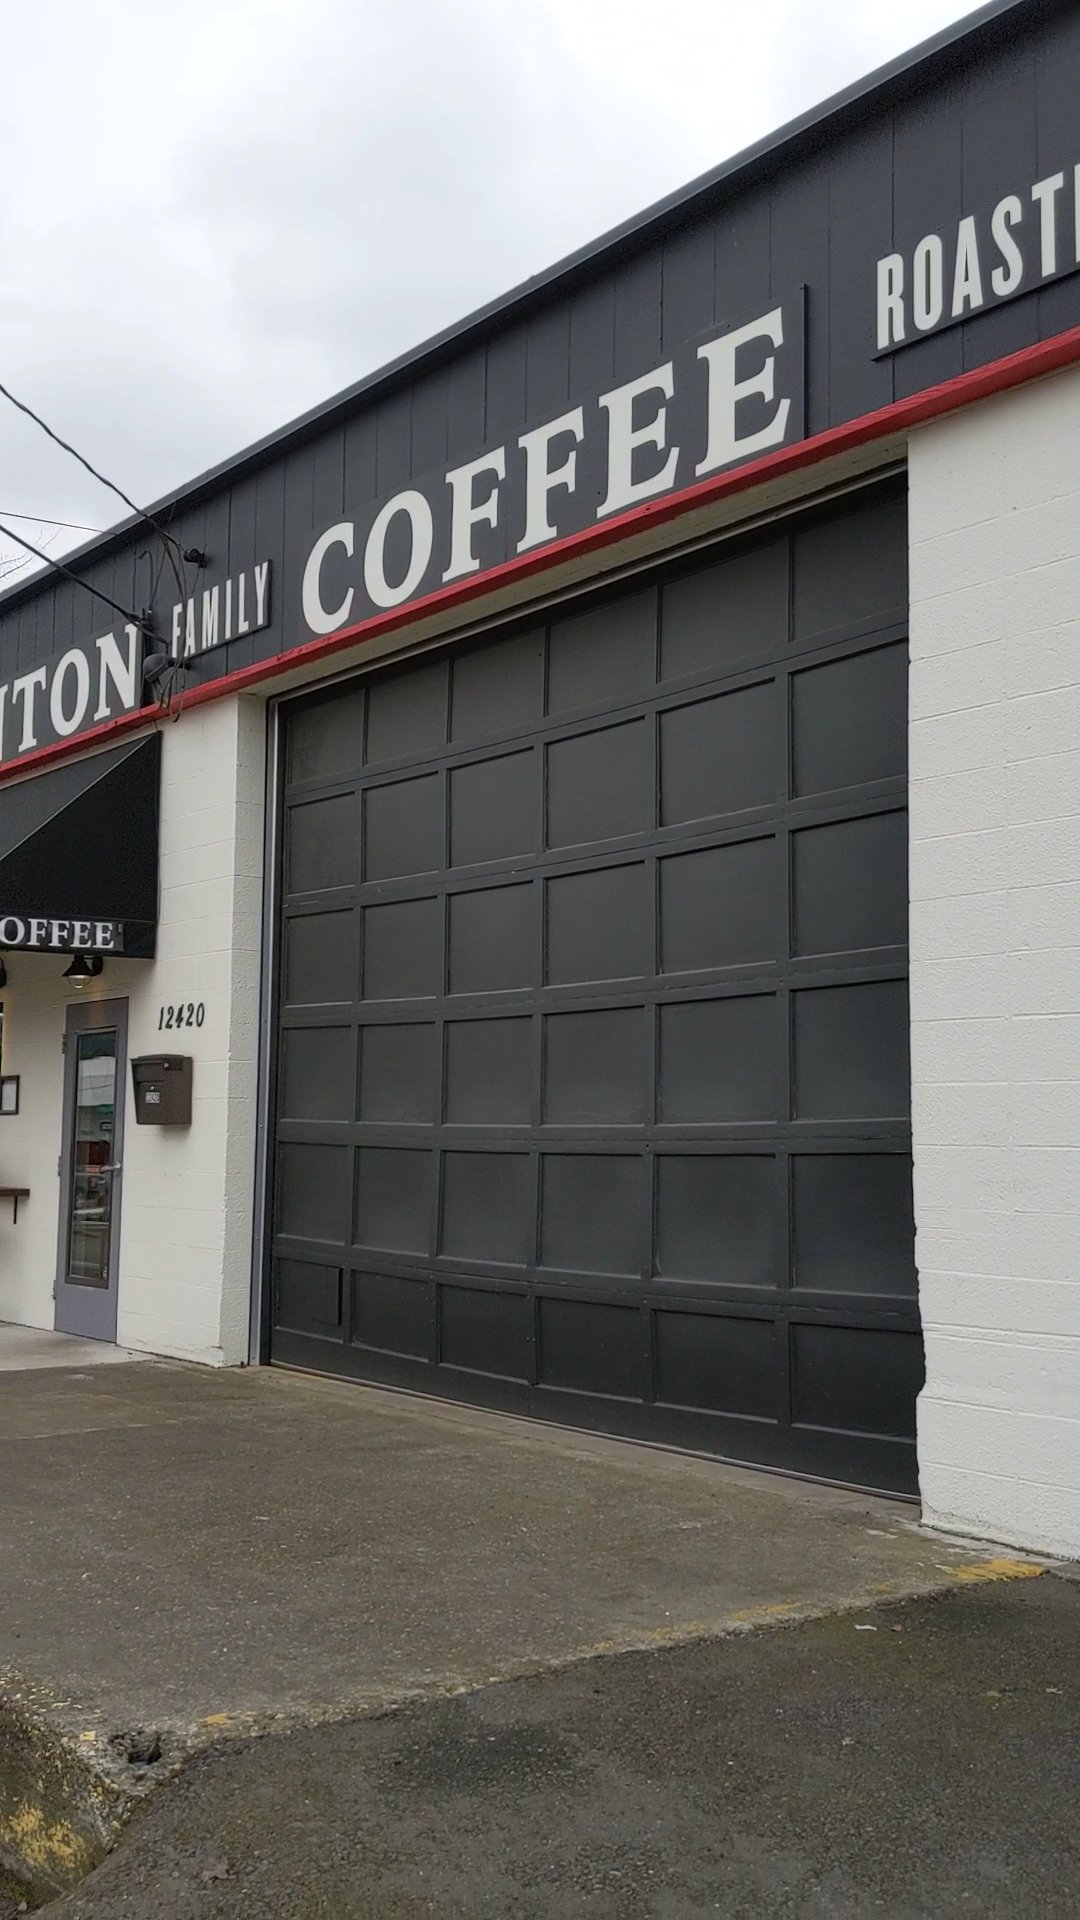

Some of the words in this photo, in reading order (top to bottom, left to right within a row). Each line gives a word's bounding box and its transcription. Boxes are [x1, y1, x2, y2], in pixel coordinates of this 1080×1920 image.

[172, 561, 268, 658] FAMILY
[302, 307, 791, 635] COFFEE
[877, 163, 1080, 350] ROAST
[0, 916, 115, 949] OFFEE
[158, 1002, 205, 1030] 12420
